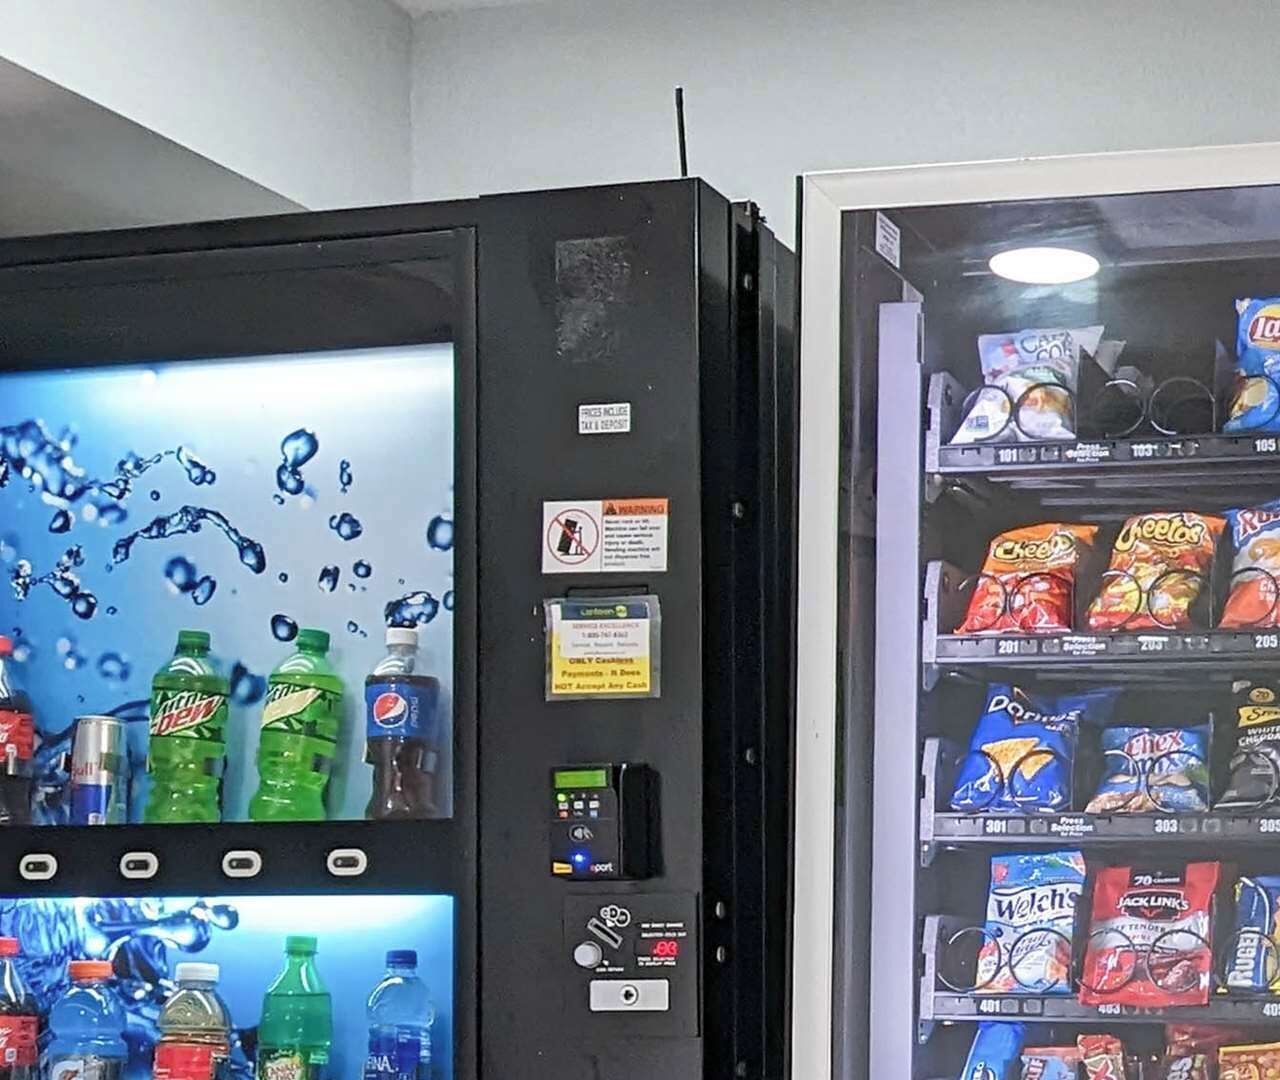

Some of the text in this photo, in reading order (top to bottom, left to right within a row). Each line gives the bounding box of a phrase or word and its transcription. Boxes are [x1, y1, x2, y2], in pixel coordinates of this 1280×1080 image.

[1131, 445, 1152, 458] 103
[1255, 439, 1276, 452] 105
[998, 448, 1018, 463] 101
[618, 504, 665, 515] WARNING
[1115, 512, 1207, 551] Cheetos
[999, 641, 1019, 653] 201
[1255, 635, 1278, 648] 205
[1124, 730, 1184, 757] Chex
[986, 820, 1007, 833] 301
[1155, 820, 1178, 833] 303
[994, 888, 1078, 920] Welch's
[1116, 897, 1149, 909] JACK
[979, 1000, 1001, 1013] 401
[1098, 1004, 1121, 1014] 403
